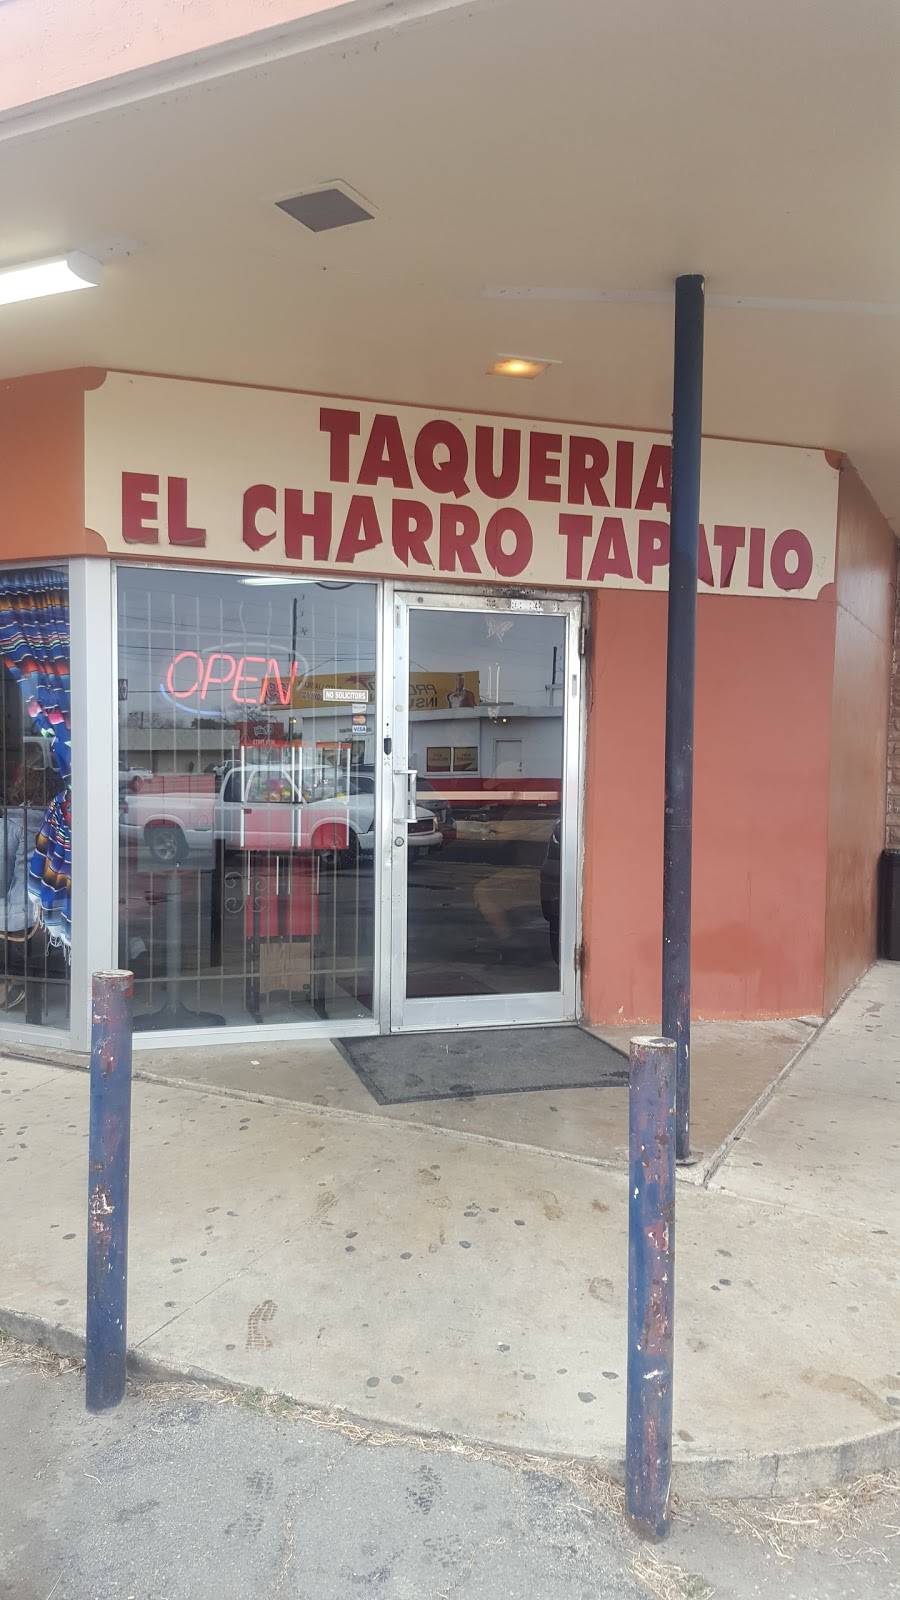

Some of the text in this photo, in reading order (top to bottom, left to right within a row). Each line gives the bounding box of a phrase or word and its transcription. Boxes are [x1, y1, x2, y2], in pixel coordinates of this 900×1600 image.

[319, 407, 673, 512] TAQUERIA
[121, 471, 207, 548] EL
[242, 483, 534, 578] CHARRO
[165, 650, 298, 706] OPEN
[325, 690, 334, 699] NO
[335, 691, 366, 700] SOLICITORS
